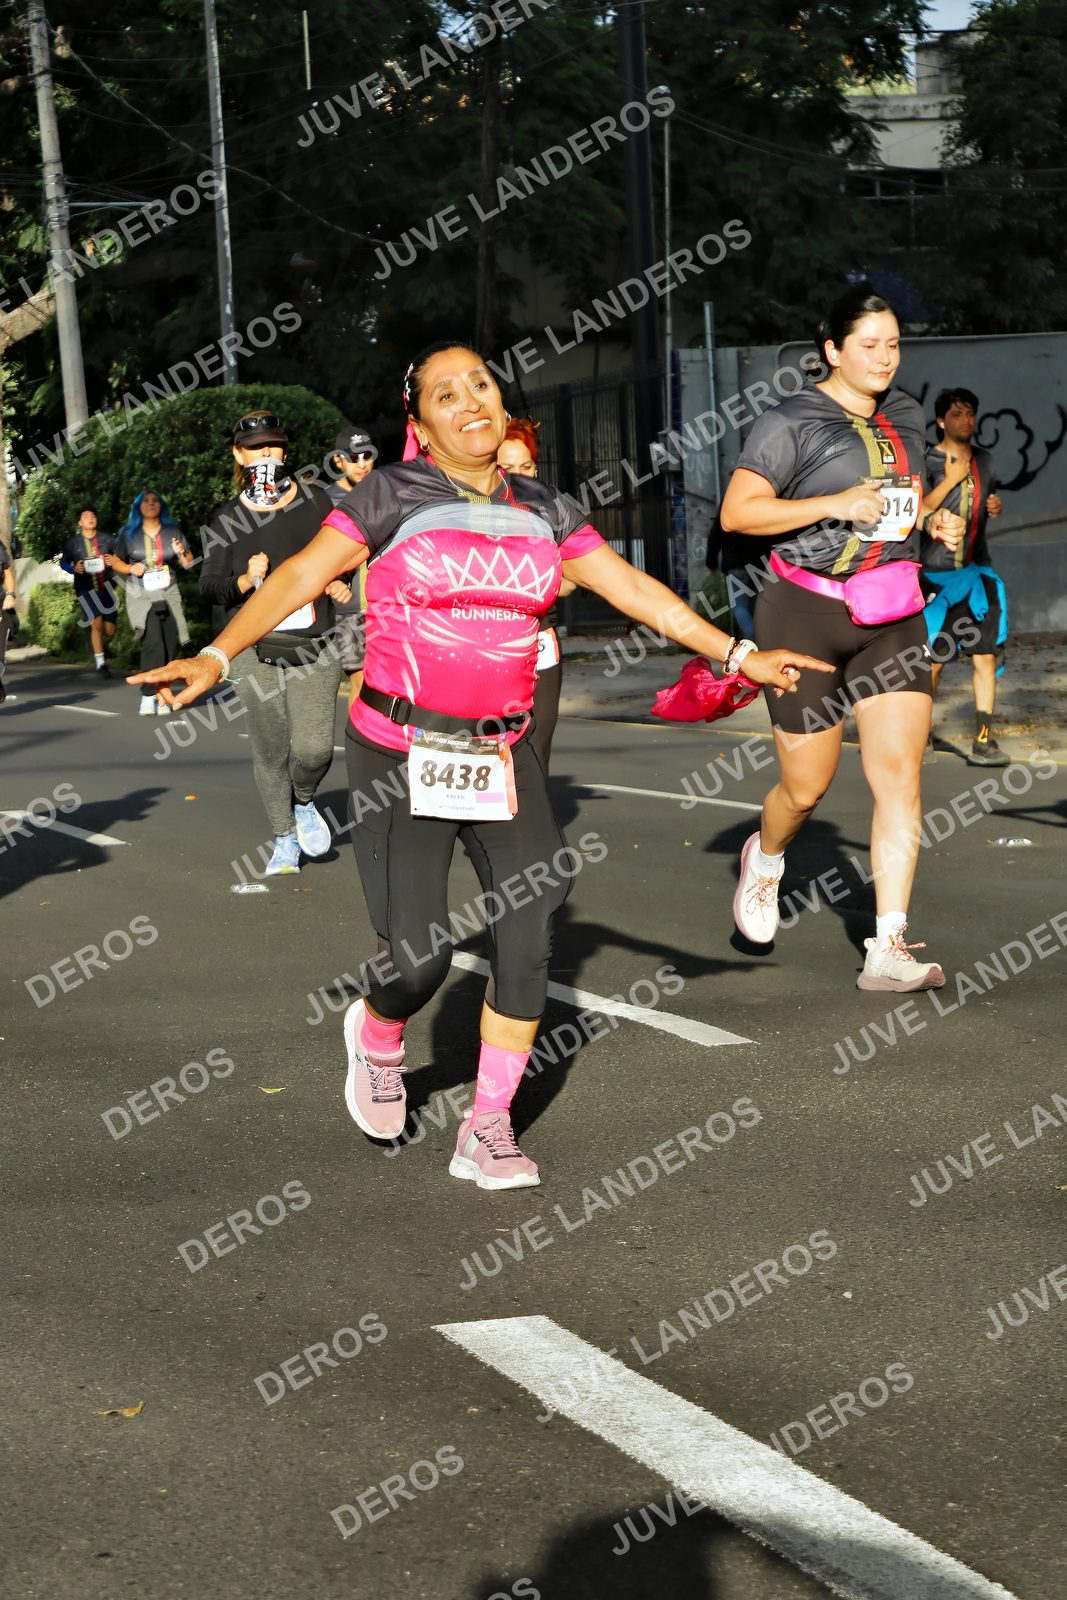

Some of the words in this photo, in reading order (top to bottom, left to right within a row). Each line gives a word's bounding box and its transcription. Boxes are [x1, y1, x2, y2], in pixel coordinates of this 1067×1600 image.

[882, 496, 914, 517] 014
[451, 607, 527, 621] RUNNERAS
[420, 760, 491, 791] 8438
